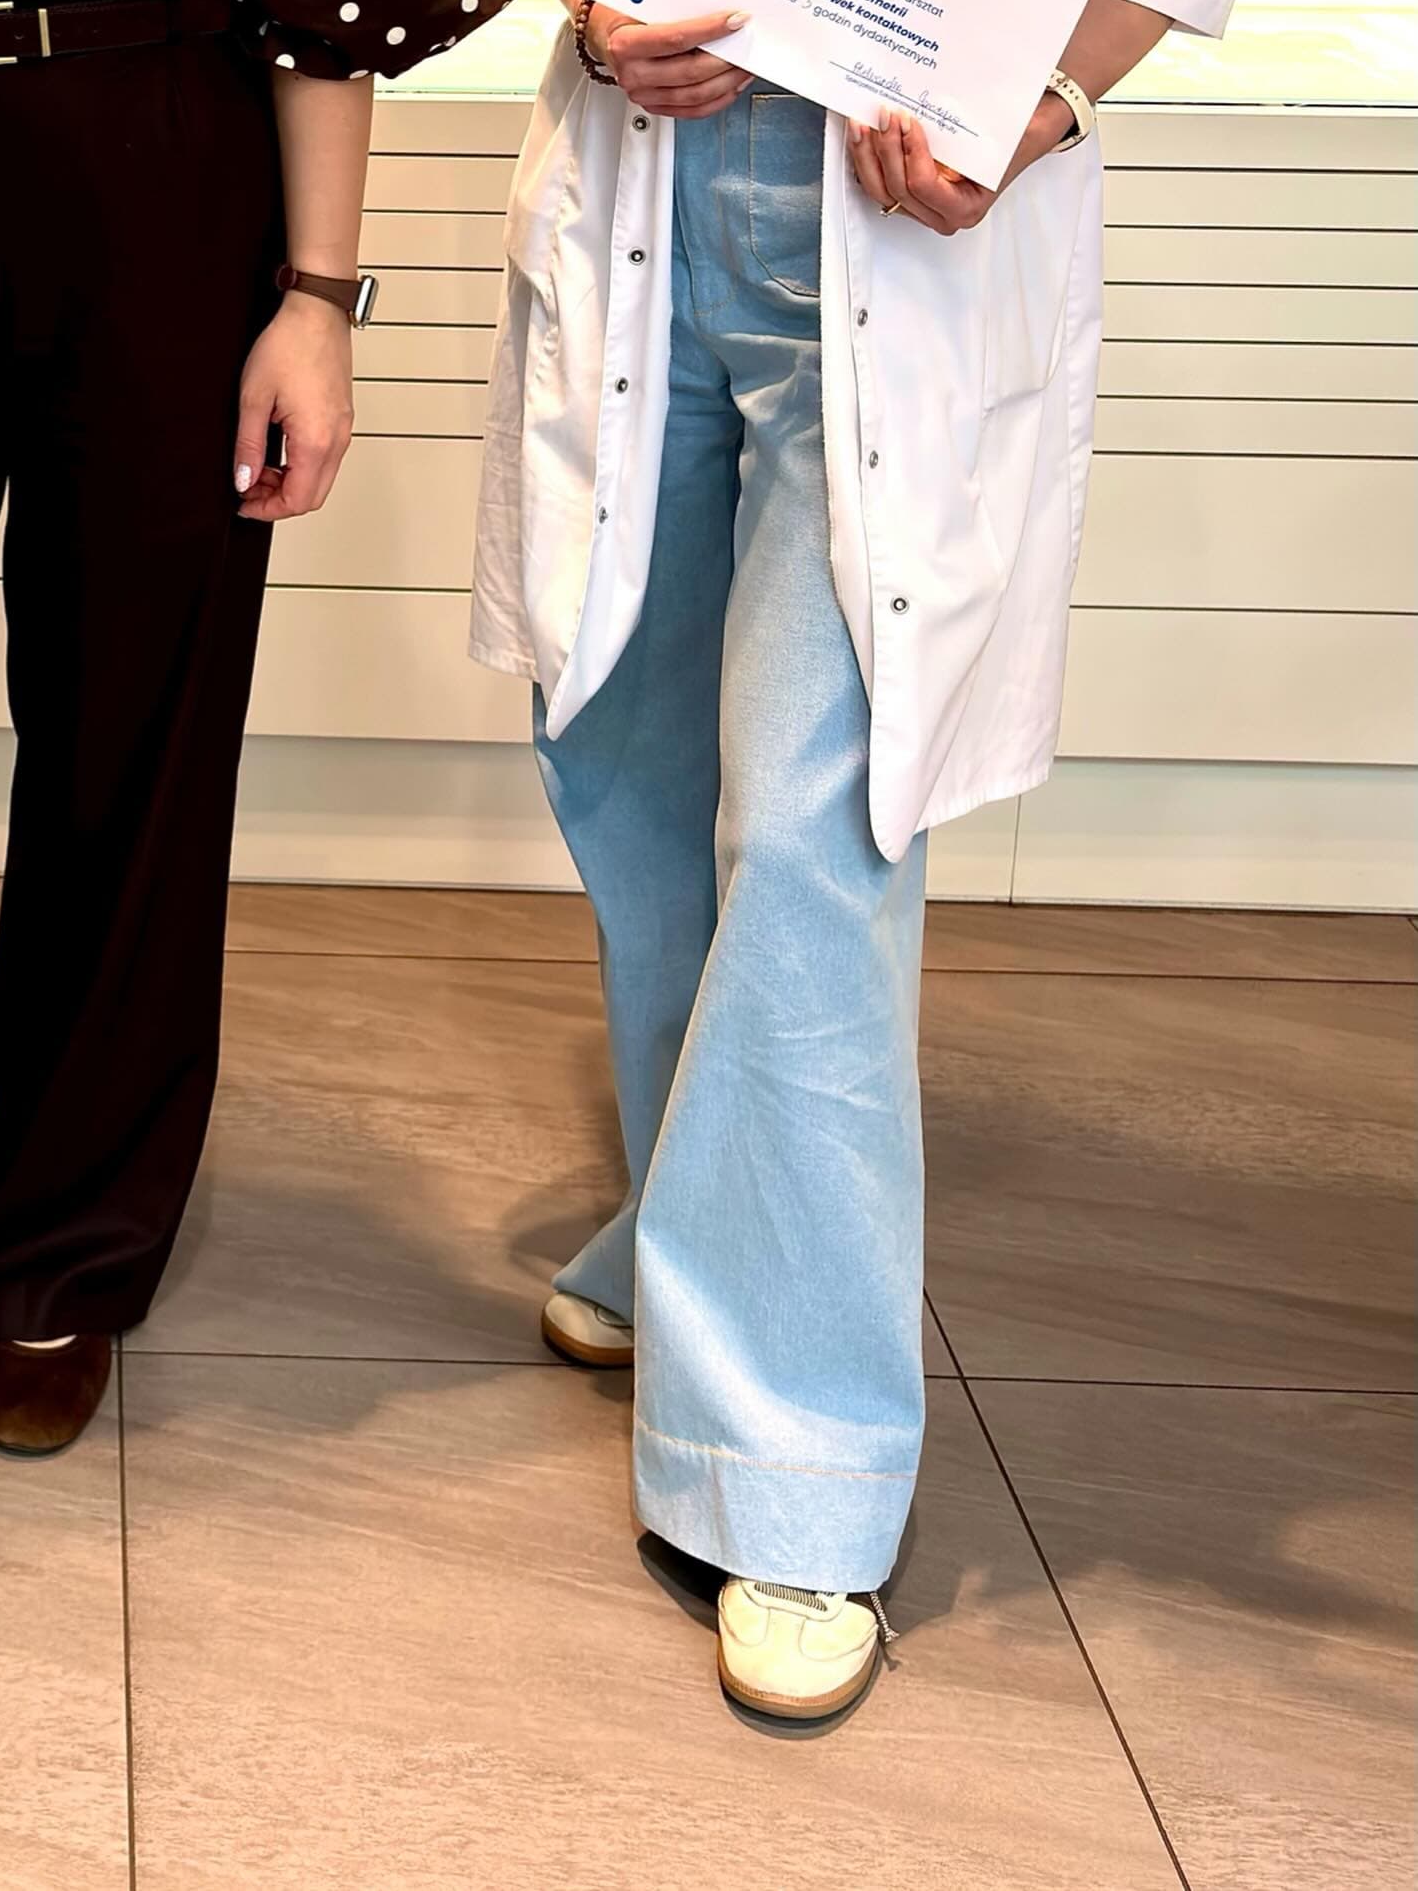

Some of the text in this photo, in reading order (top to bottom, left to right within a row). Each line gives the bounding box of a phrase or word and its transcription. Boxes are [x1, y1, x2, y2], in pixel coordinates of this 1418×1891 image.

[813, 5, 852, 30] godzin
[853, 22, 937, 70] dydaktycznych
[855, 6, 939, 52] kontaktowych
